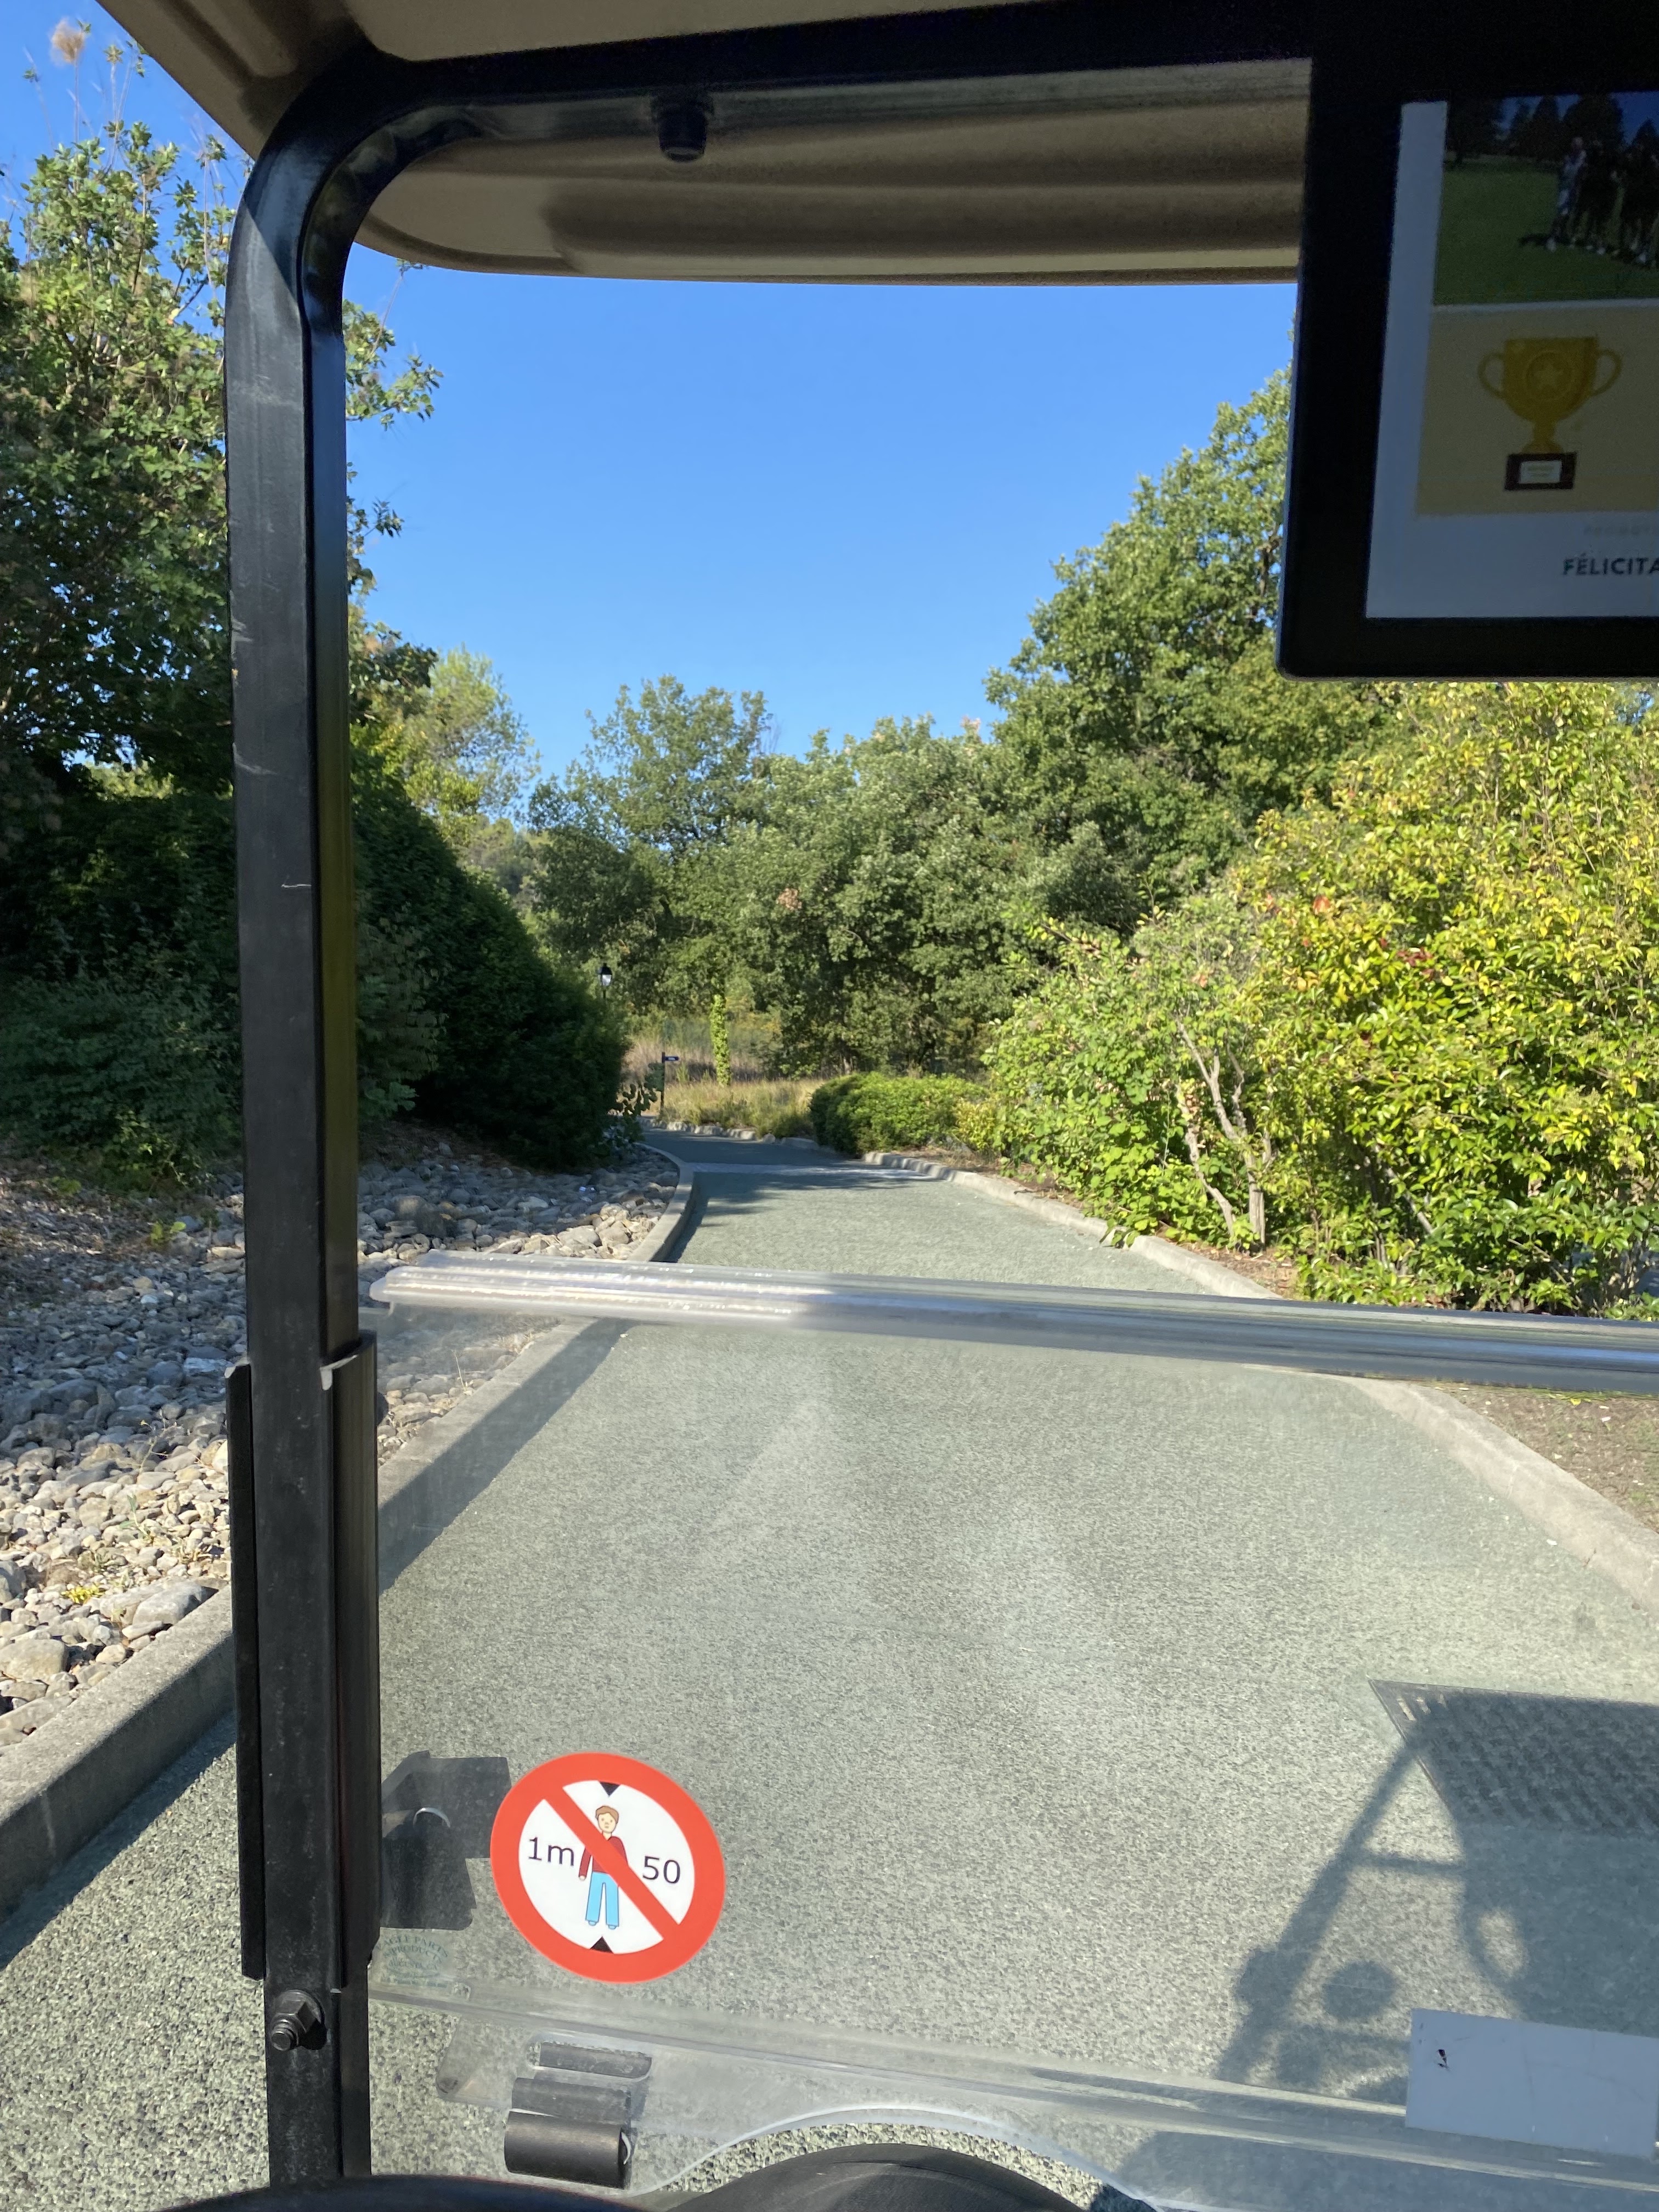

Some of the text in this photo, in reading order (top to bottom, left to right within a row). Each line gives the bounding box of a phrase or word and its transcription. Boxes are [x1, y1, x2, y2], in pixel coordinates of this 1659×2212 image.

[528, 1837, 681, 1884] 1m 50
[415, 1936, 449, 1957] PARTS
